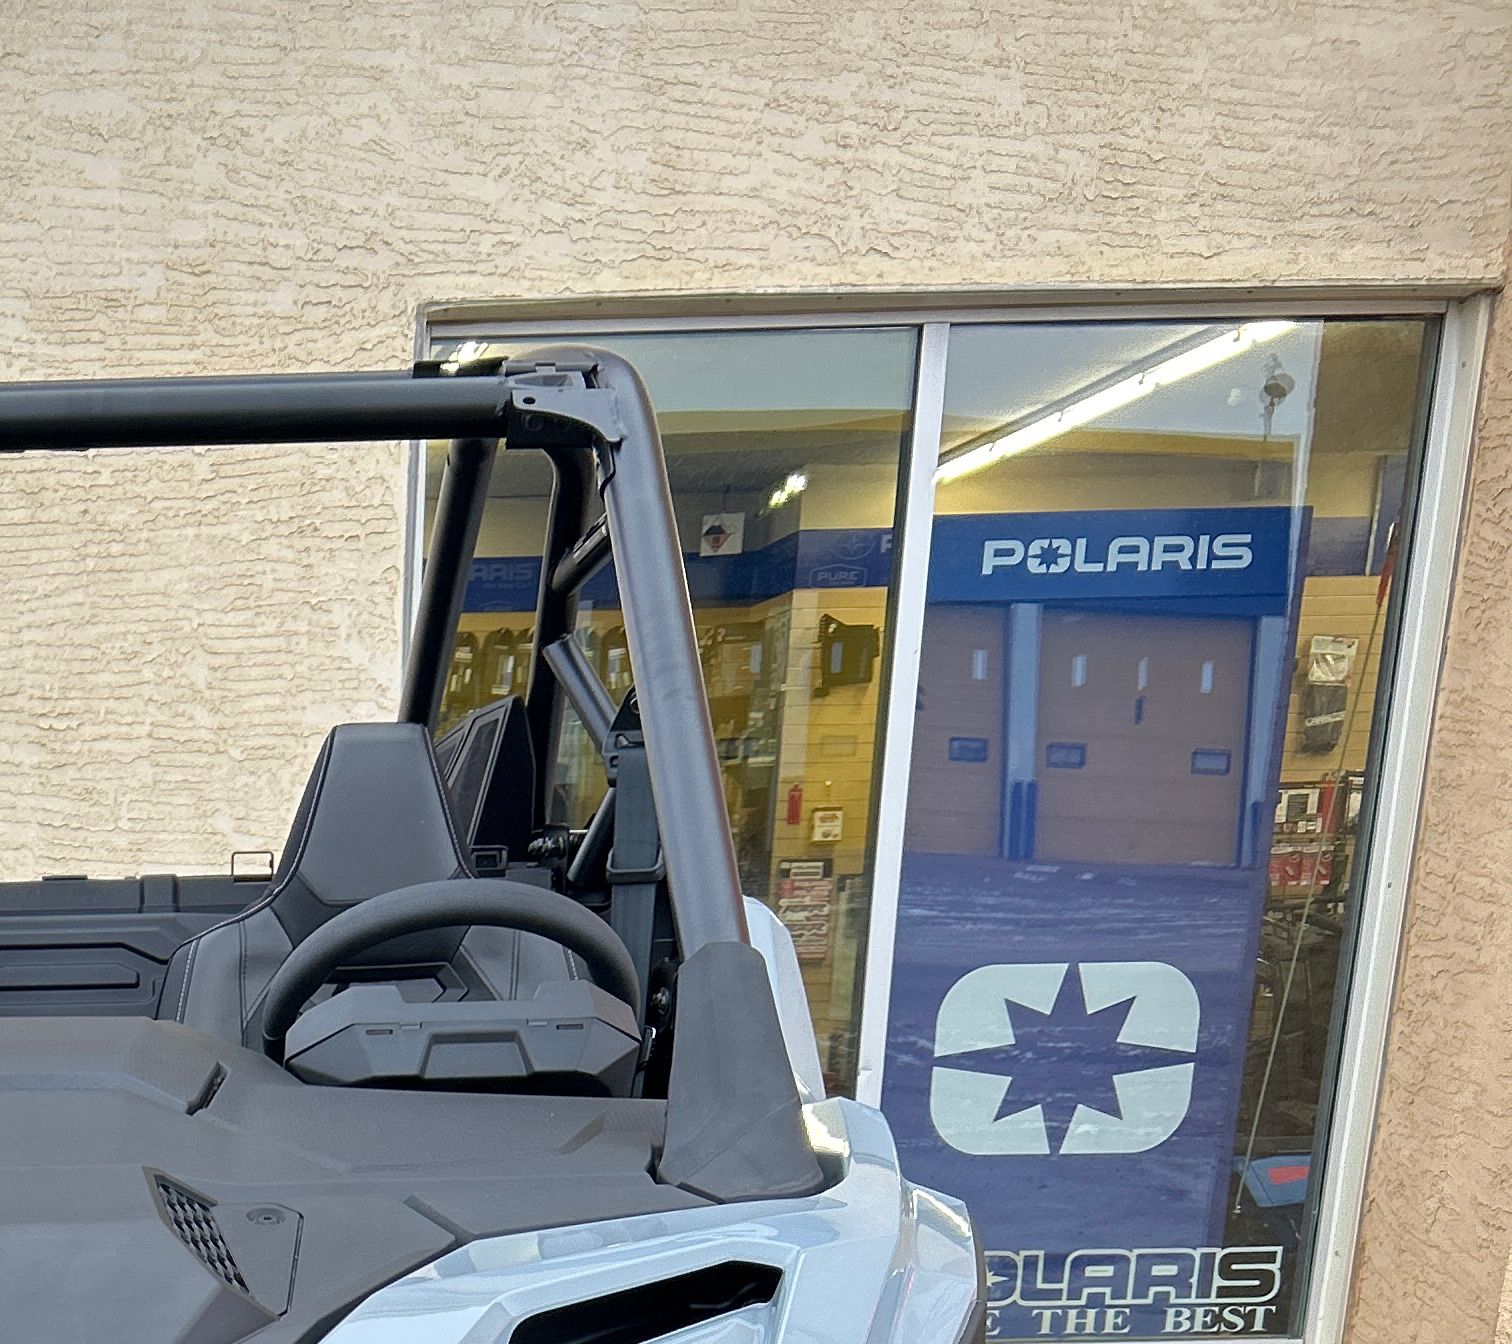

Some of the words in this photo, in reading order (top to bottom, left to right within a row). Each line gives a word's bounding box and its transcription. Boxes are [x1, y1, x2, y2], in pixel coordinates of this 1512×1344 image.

[982, 533, 1253, 575] POLARIS
[816, 571, 861, 581] PURE
[984, 1246, 1284, 1307] OLARIS
[1032, 1306, 1131, 1335] THE
[1160, 1304, 1277, 1334] BEST
